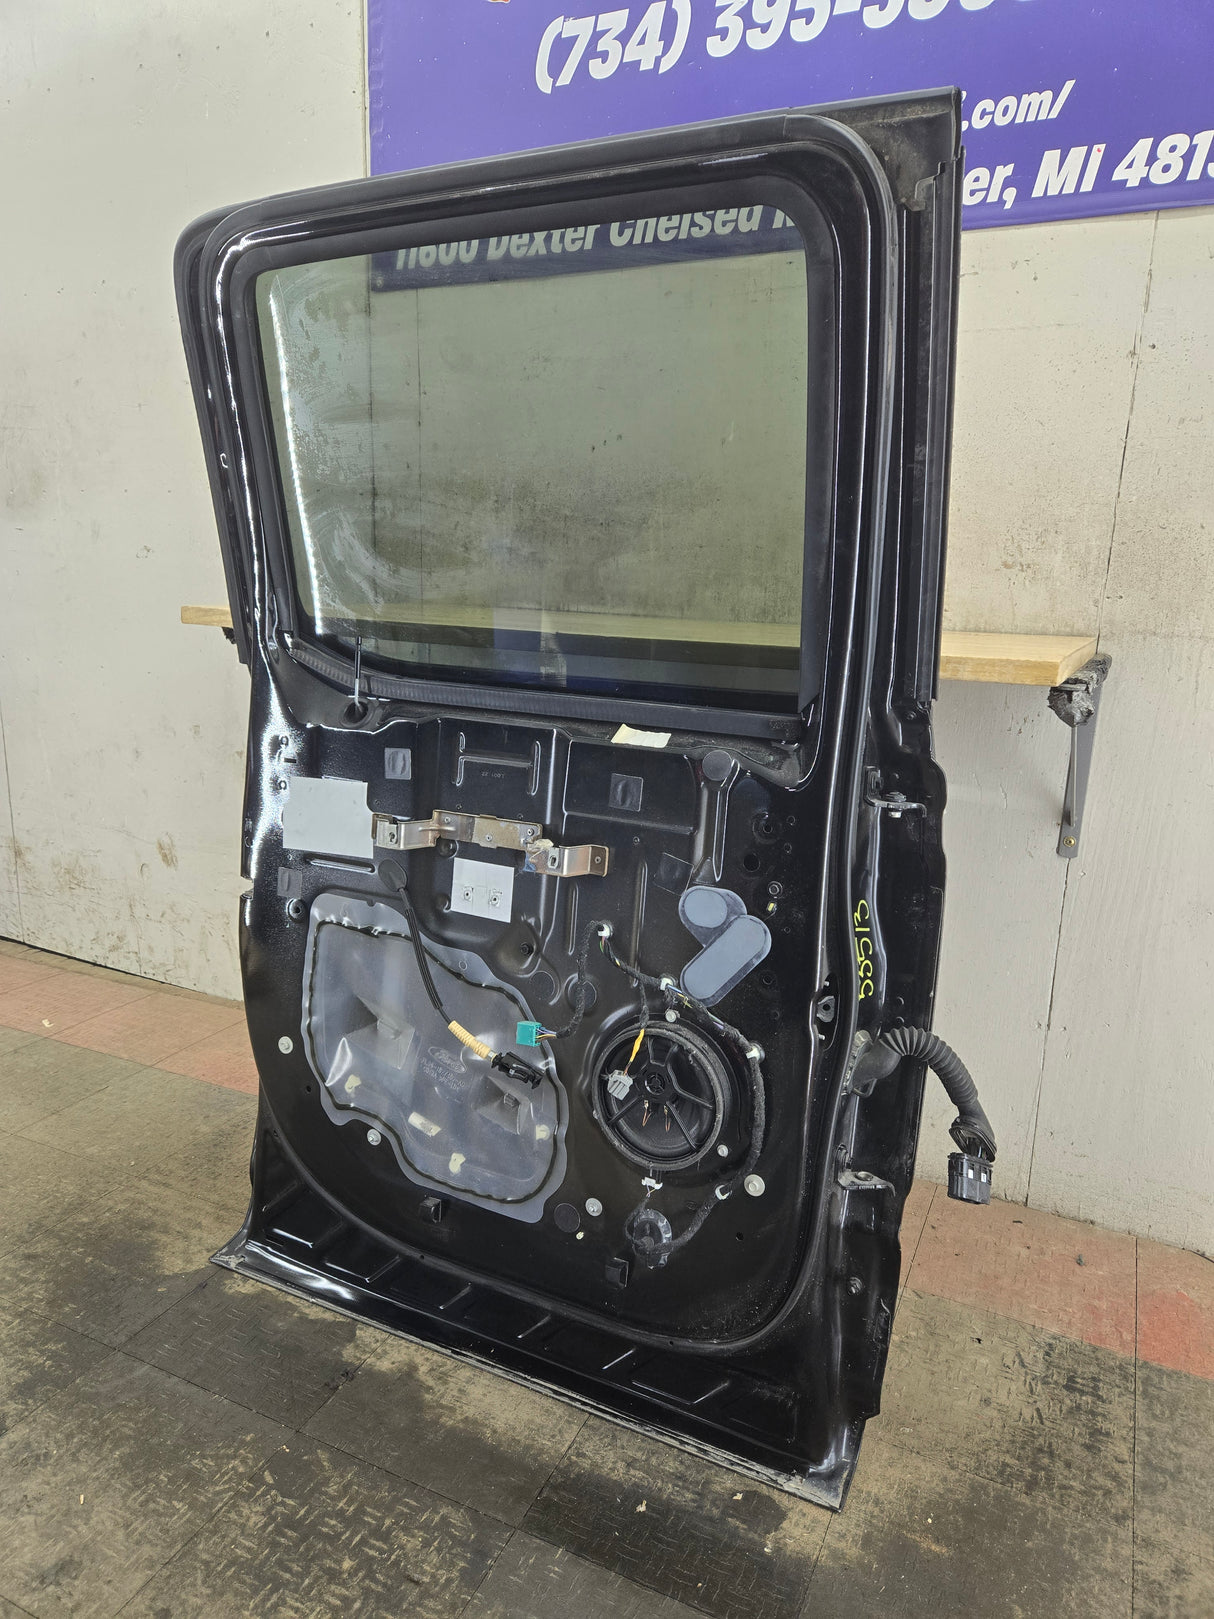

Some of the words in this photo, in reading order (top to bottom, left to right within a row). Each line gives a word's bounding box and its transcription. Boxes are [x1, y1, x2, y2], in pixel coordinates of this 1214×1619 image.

[535, 0, 692, 94] (734)
[486, 224, 601, 261] Dexter
[1031, 143, 1107, 197] MI
[1111, 129, 1214, 187] 481
